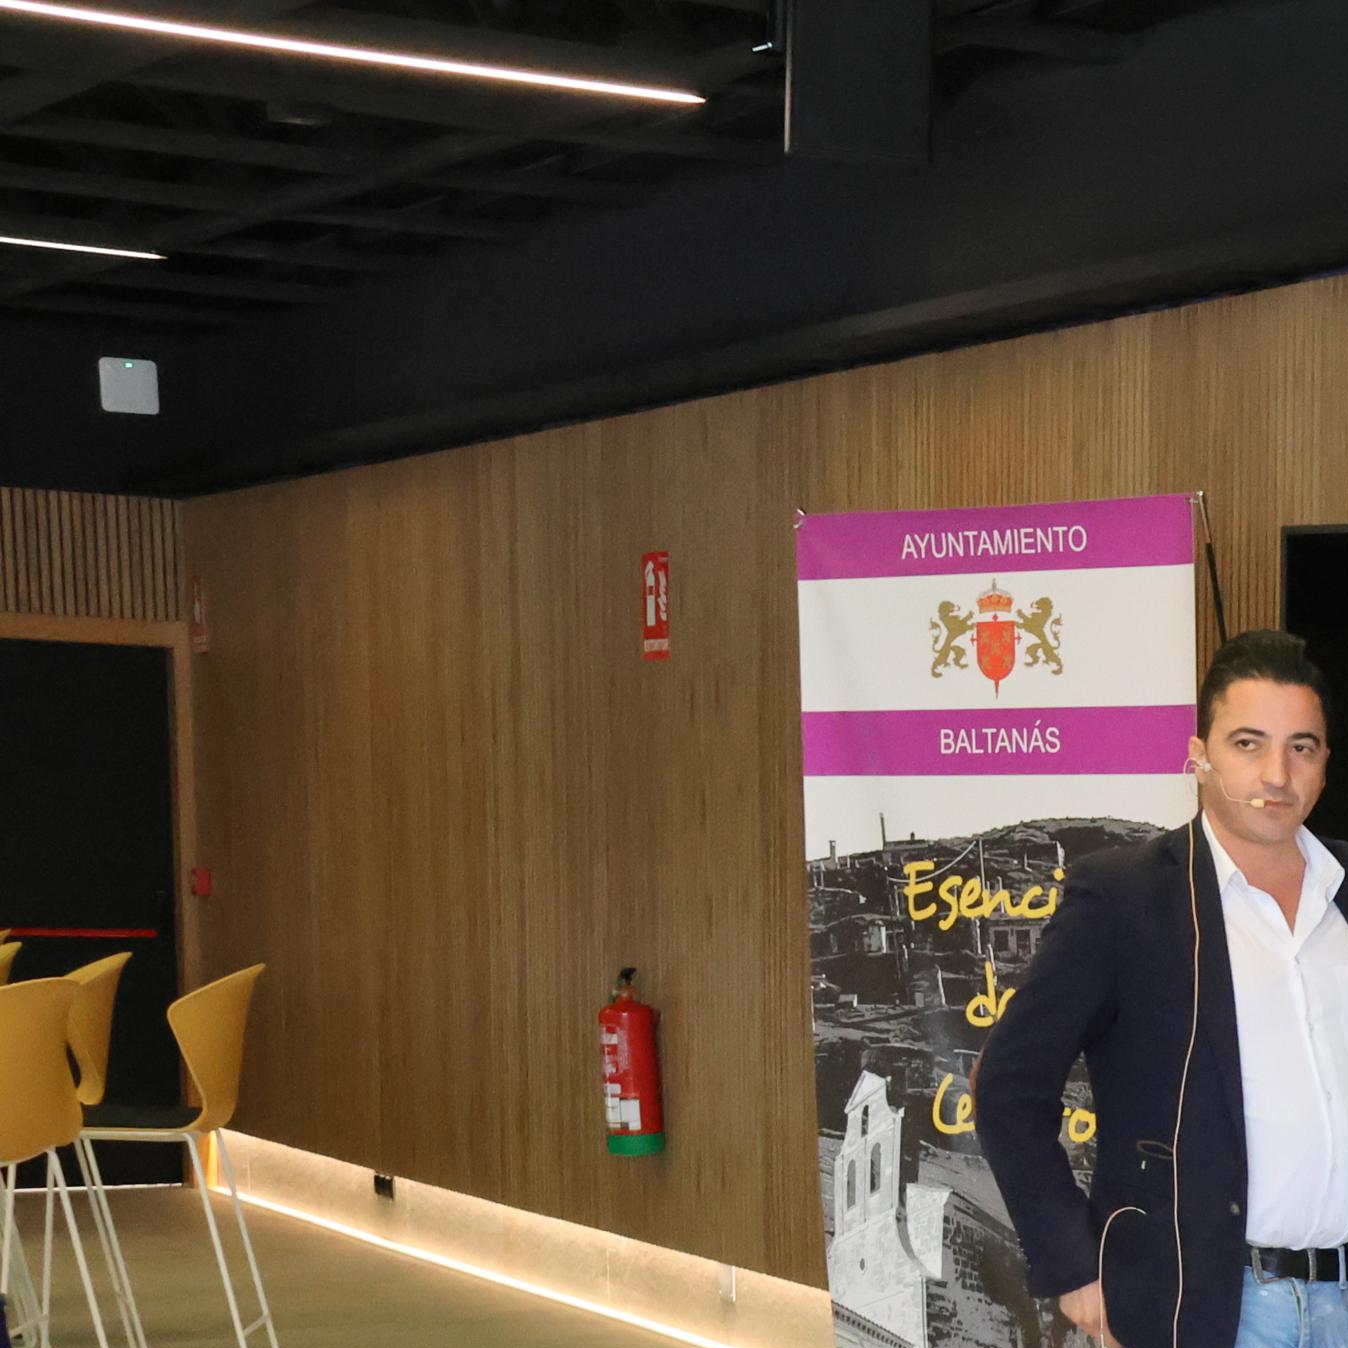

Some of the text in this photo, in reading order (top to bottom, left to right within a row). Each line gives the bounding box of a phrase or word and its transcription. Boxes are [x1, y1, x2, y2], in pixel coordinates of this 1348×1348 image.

[901, 525, 1088, 560] AYUNTAMIENTO
[939, 719, 1061, 755] BALTANÁS
[903, 860, 1065, 931] Esenci
